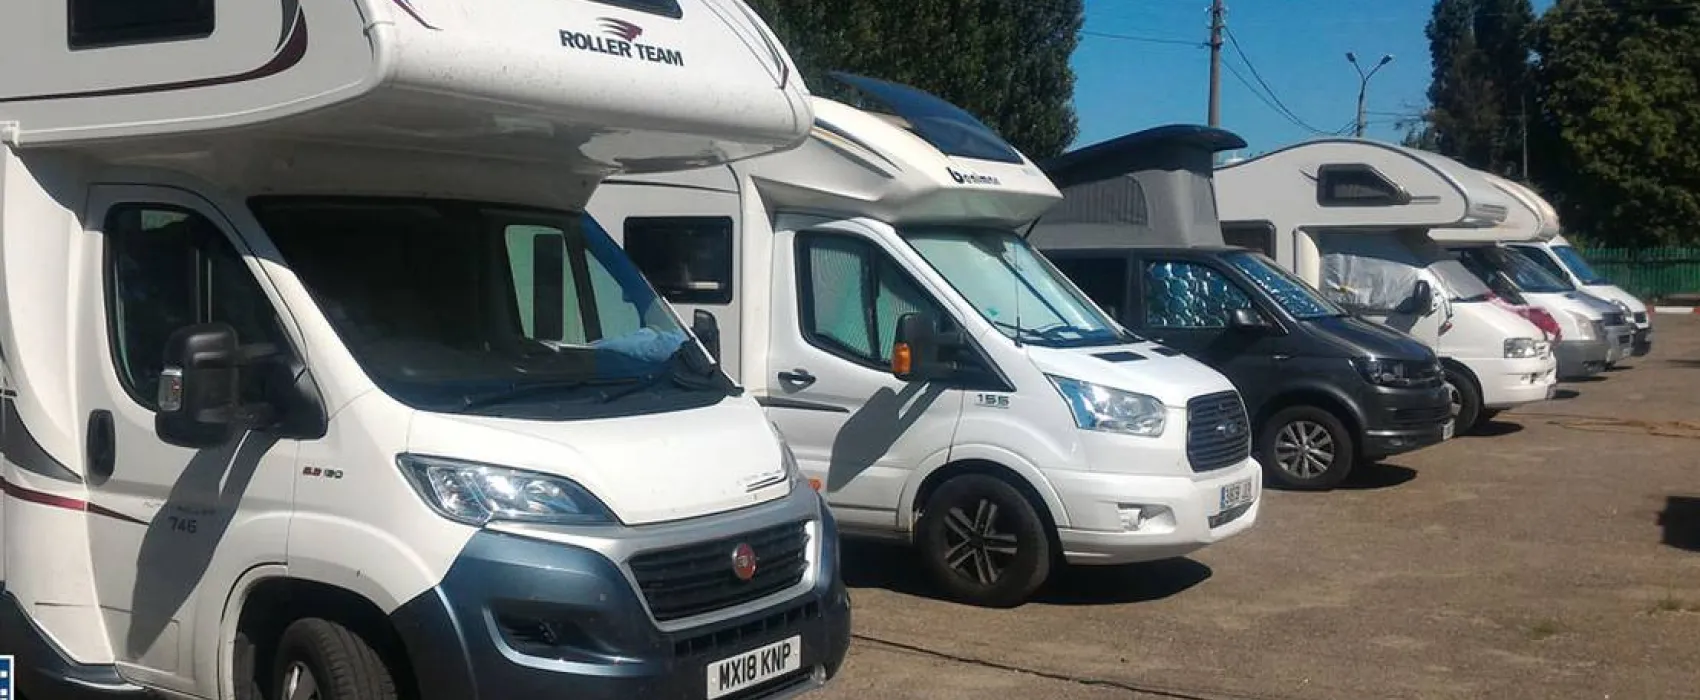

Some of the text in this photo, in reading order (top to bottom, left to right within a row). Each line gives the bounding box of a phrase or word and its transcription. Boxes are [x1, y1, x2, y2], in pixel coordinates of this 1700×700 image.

[559, 29, 684, 66] ROLLER TEAM
[719, 642, 791, 691] MX18 KNP
